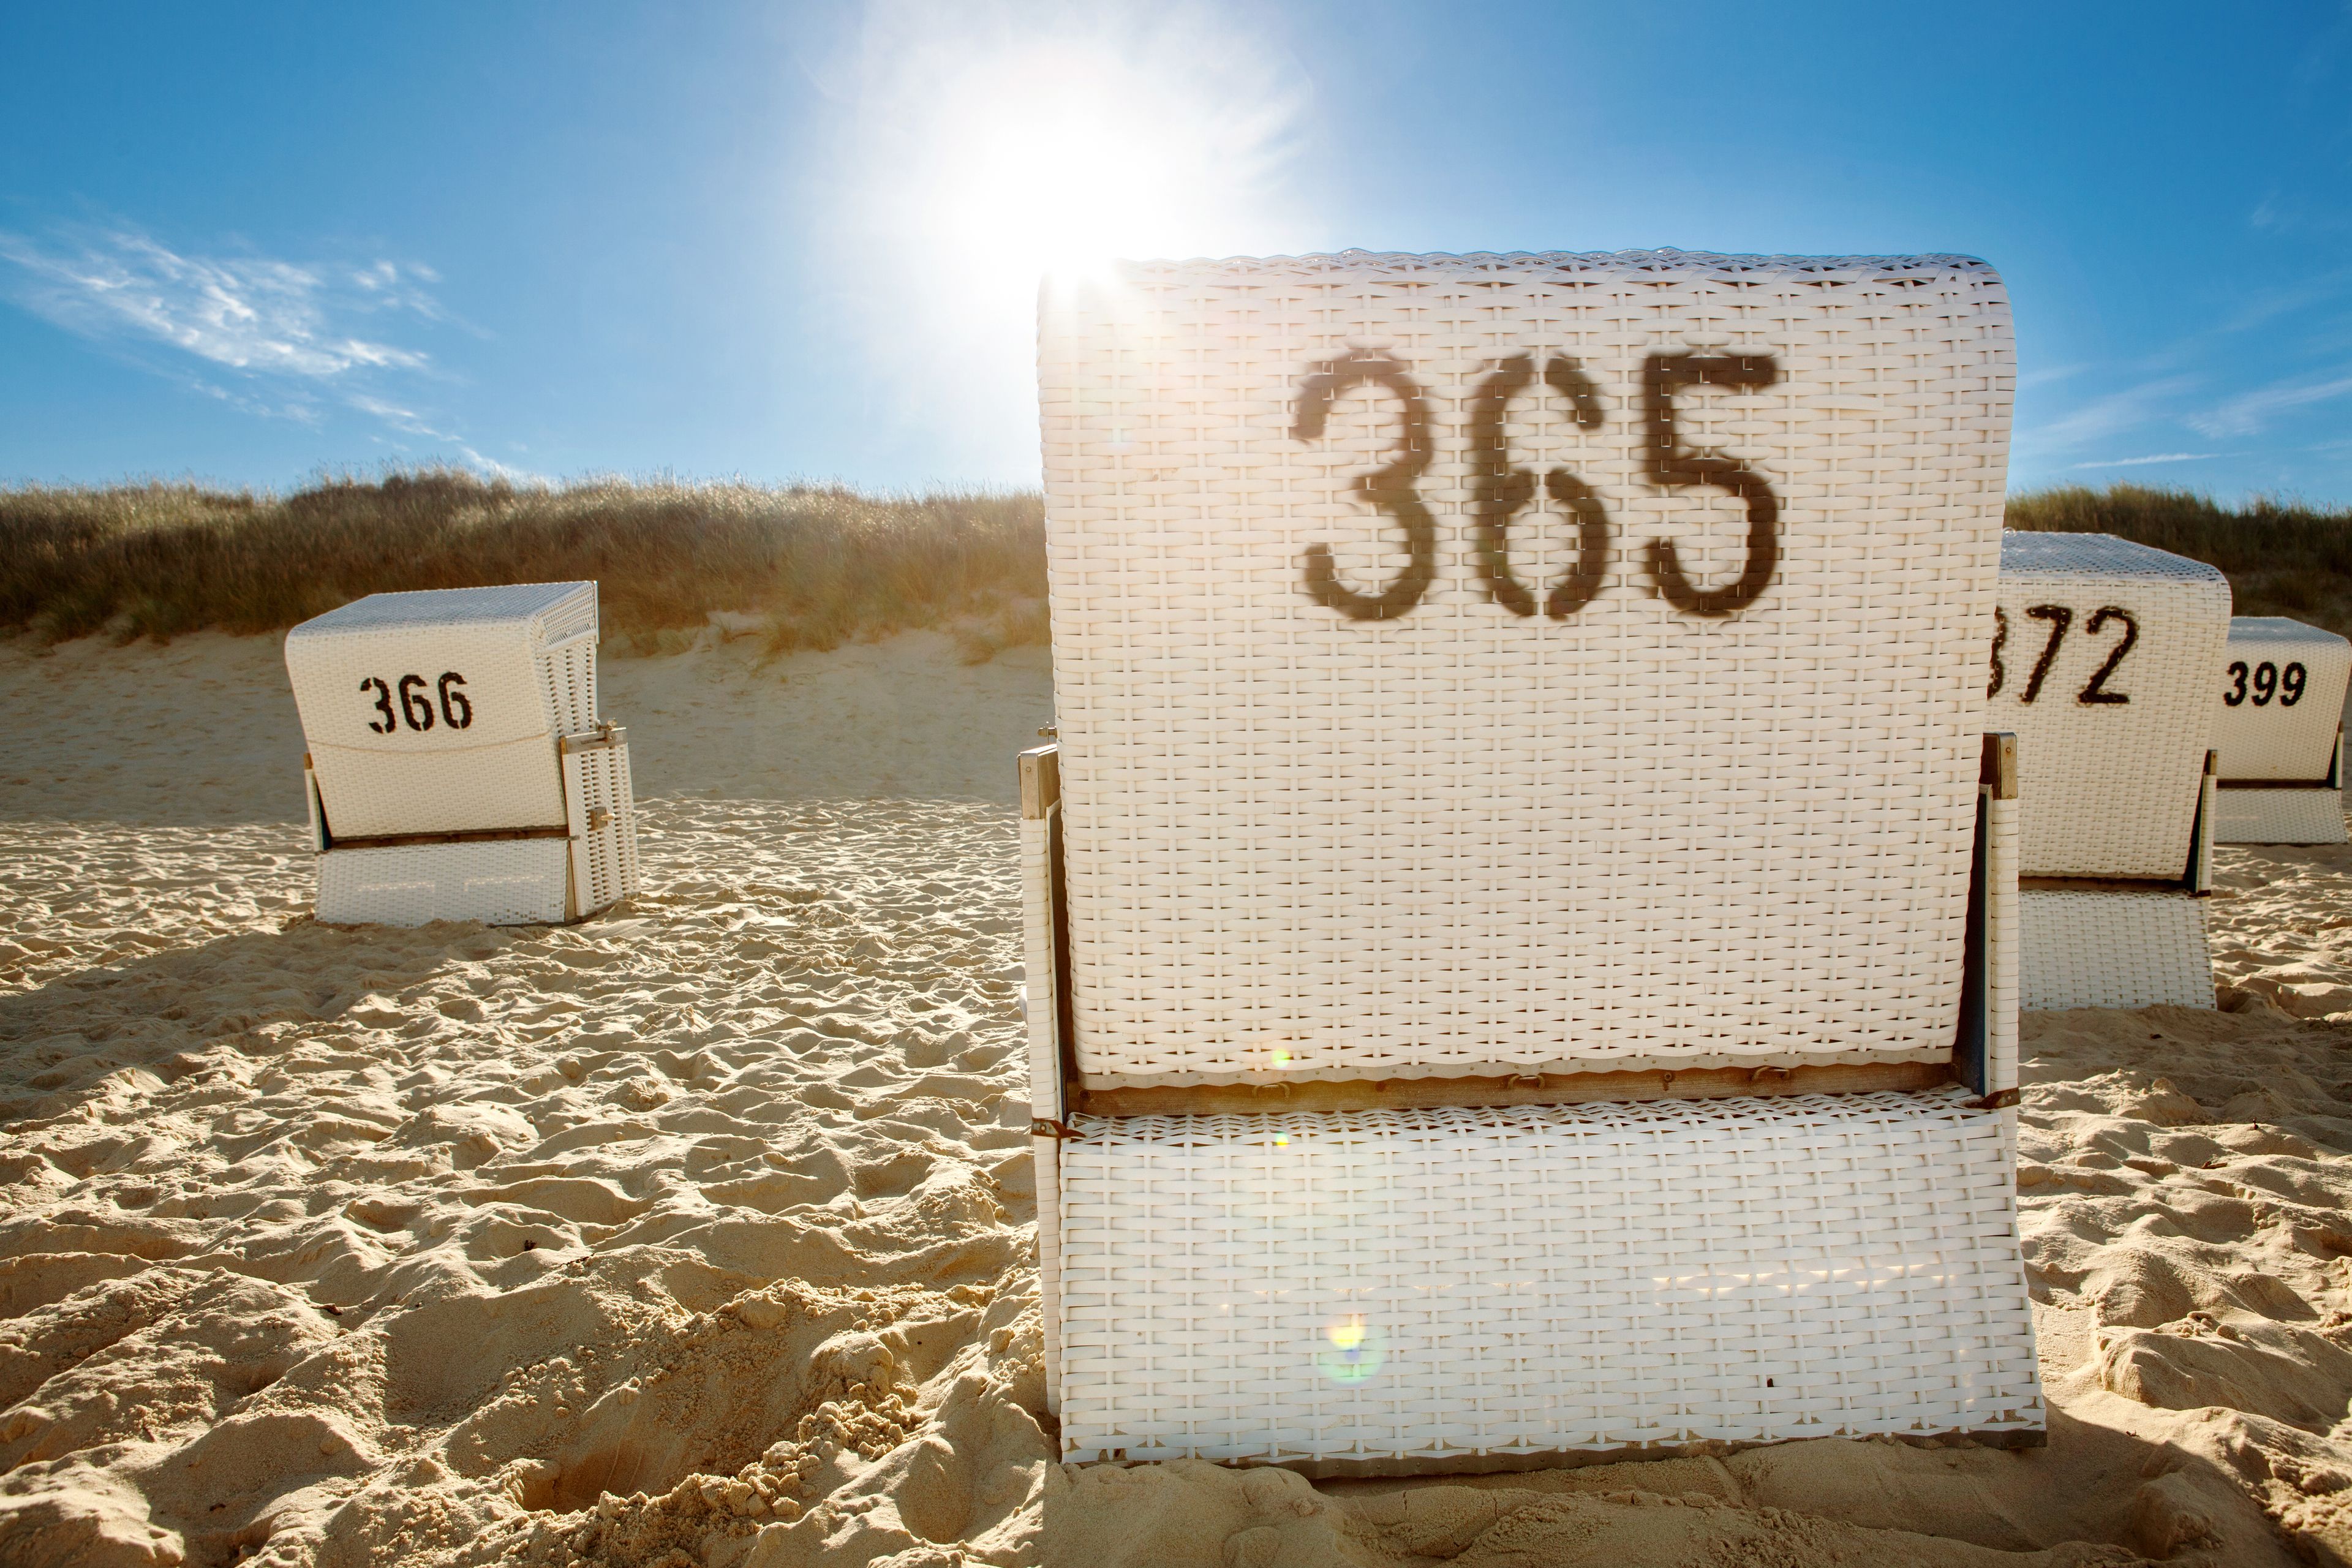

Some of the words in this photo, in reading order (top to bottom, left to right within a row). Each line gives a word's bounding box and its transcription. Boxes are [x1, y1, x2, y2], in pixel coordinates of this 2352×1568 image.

[1291, 348, 1781, 622] 365
[360, 671, 473, 734] 366
[2223, 661, 2308, 707] 399
